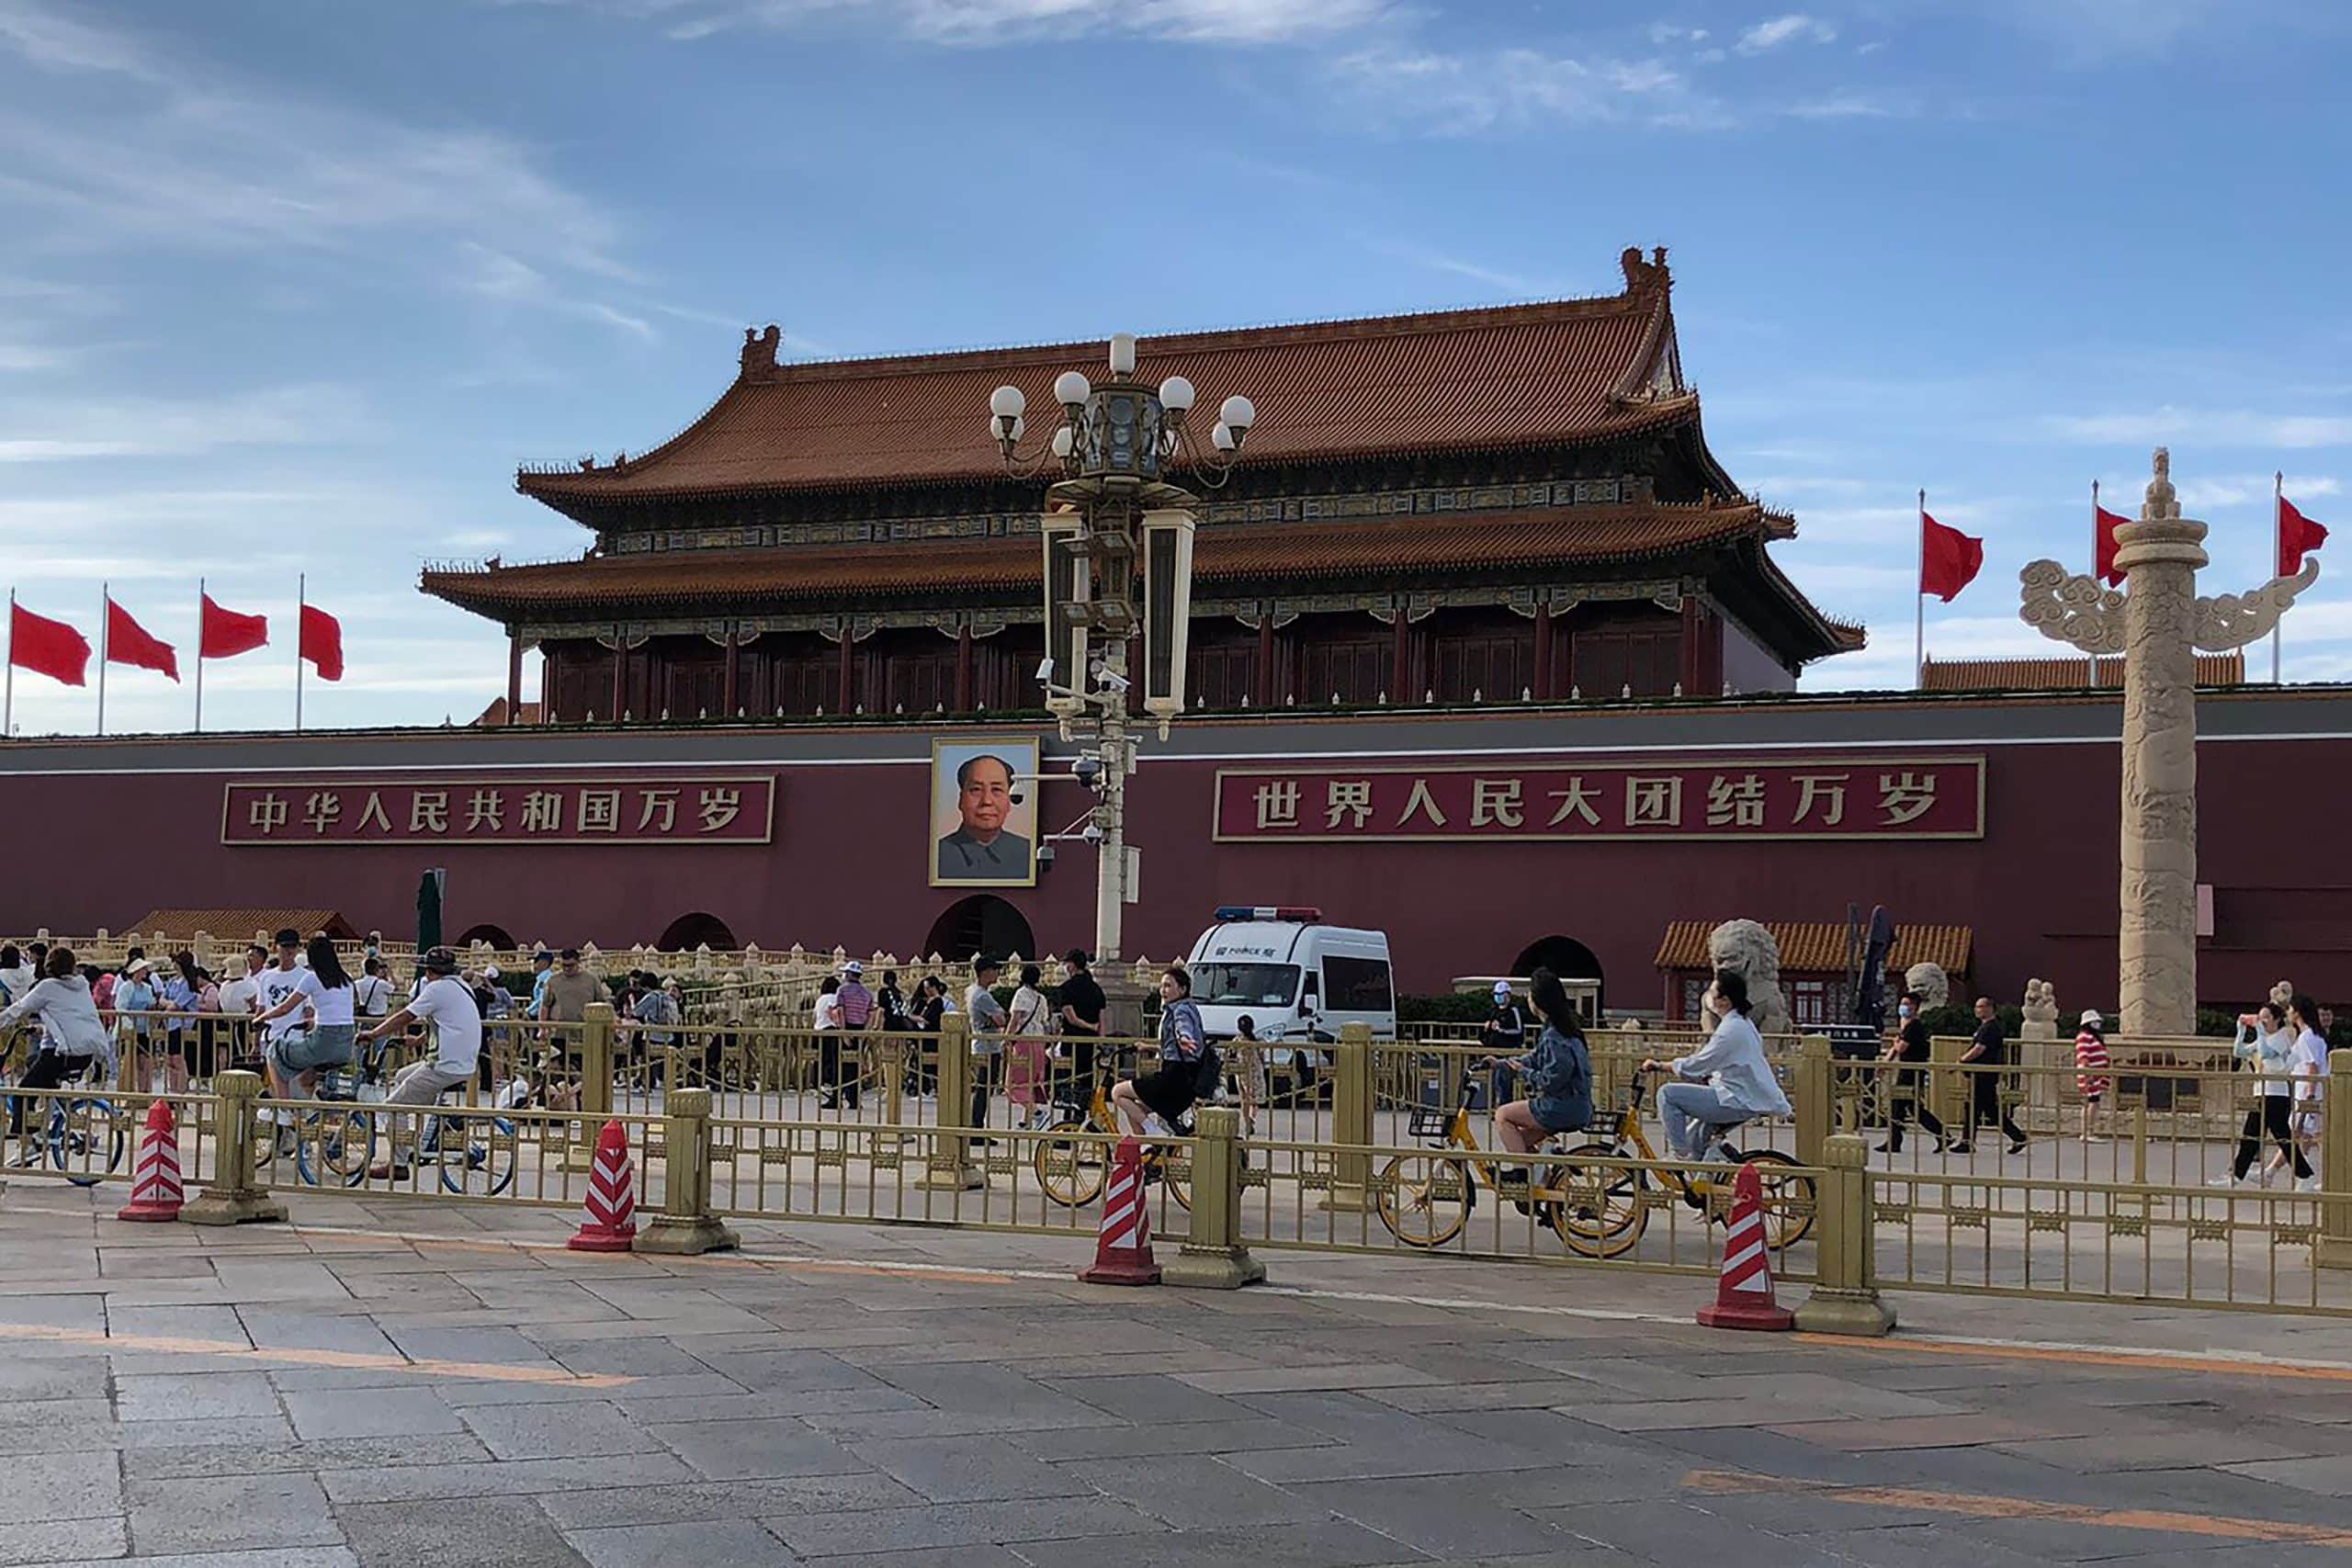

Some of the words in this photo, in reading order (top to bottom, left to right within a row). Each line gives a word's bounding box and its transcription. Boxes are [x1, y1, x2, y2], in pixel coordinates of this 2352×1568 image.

[249, 788, 741, 834] 中华人民共和国万岁
[1252, 773, 1936, 829] 世界人民大团结万岁
